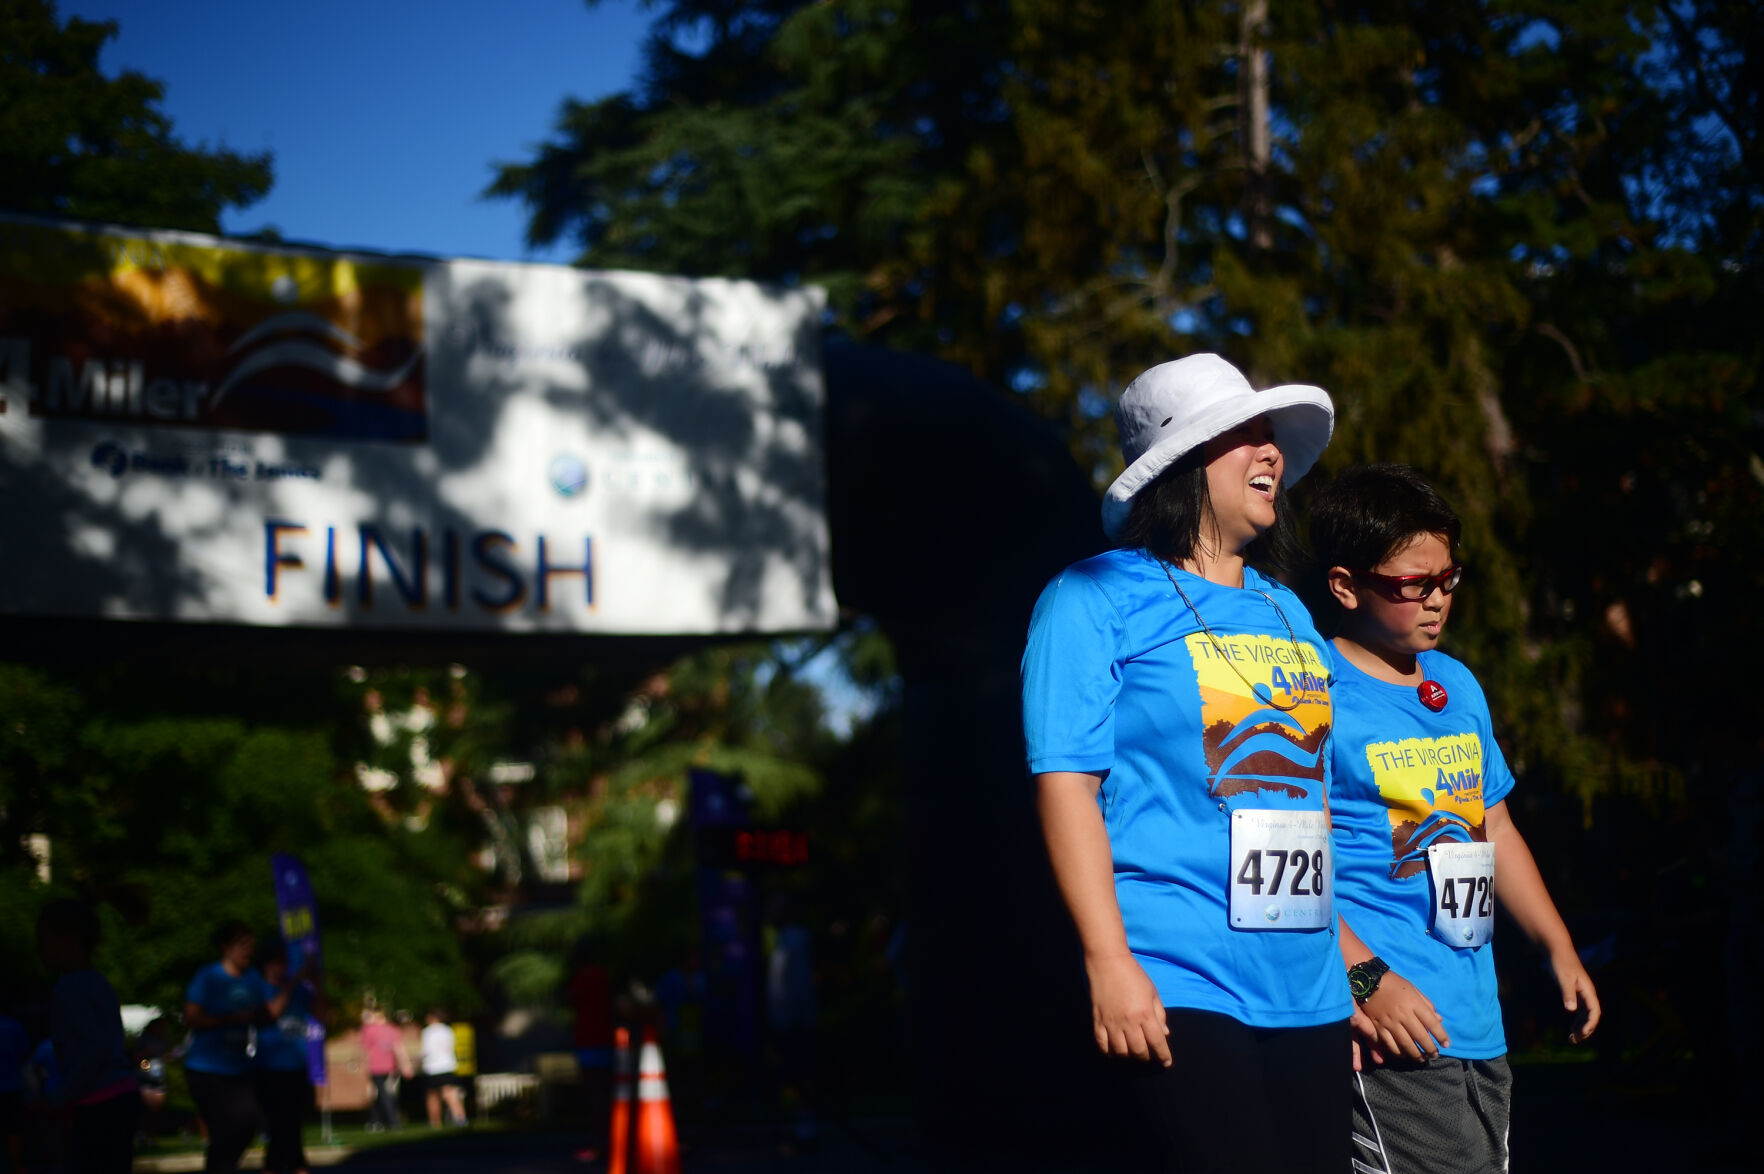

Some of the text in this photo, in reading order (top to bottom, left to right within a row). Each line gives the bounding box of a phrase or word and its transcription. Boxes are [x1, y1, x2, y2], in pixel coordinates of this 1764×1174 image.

[46, 355, 209, 421] Miler
[265, 516, 599, 614] FINISH
[1195, 641, 1320, 667] THE VIRGINIA
[1271, 666, 1292, 695] 4
[1376, 742, 1480, 771] THE VIRGINIA
[1436, 768, 1454, 796] 4
[1236, 849, 1324, 897] 4728
[1441, 875, 1494, 919] 4729
[1283, 909, 1327, 919] CENTR
